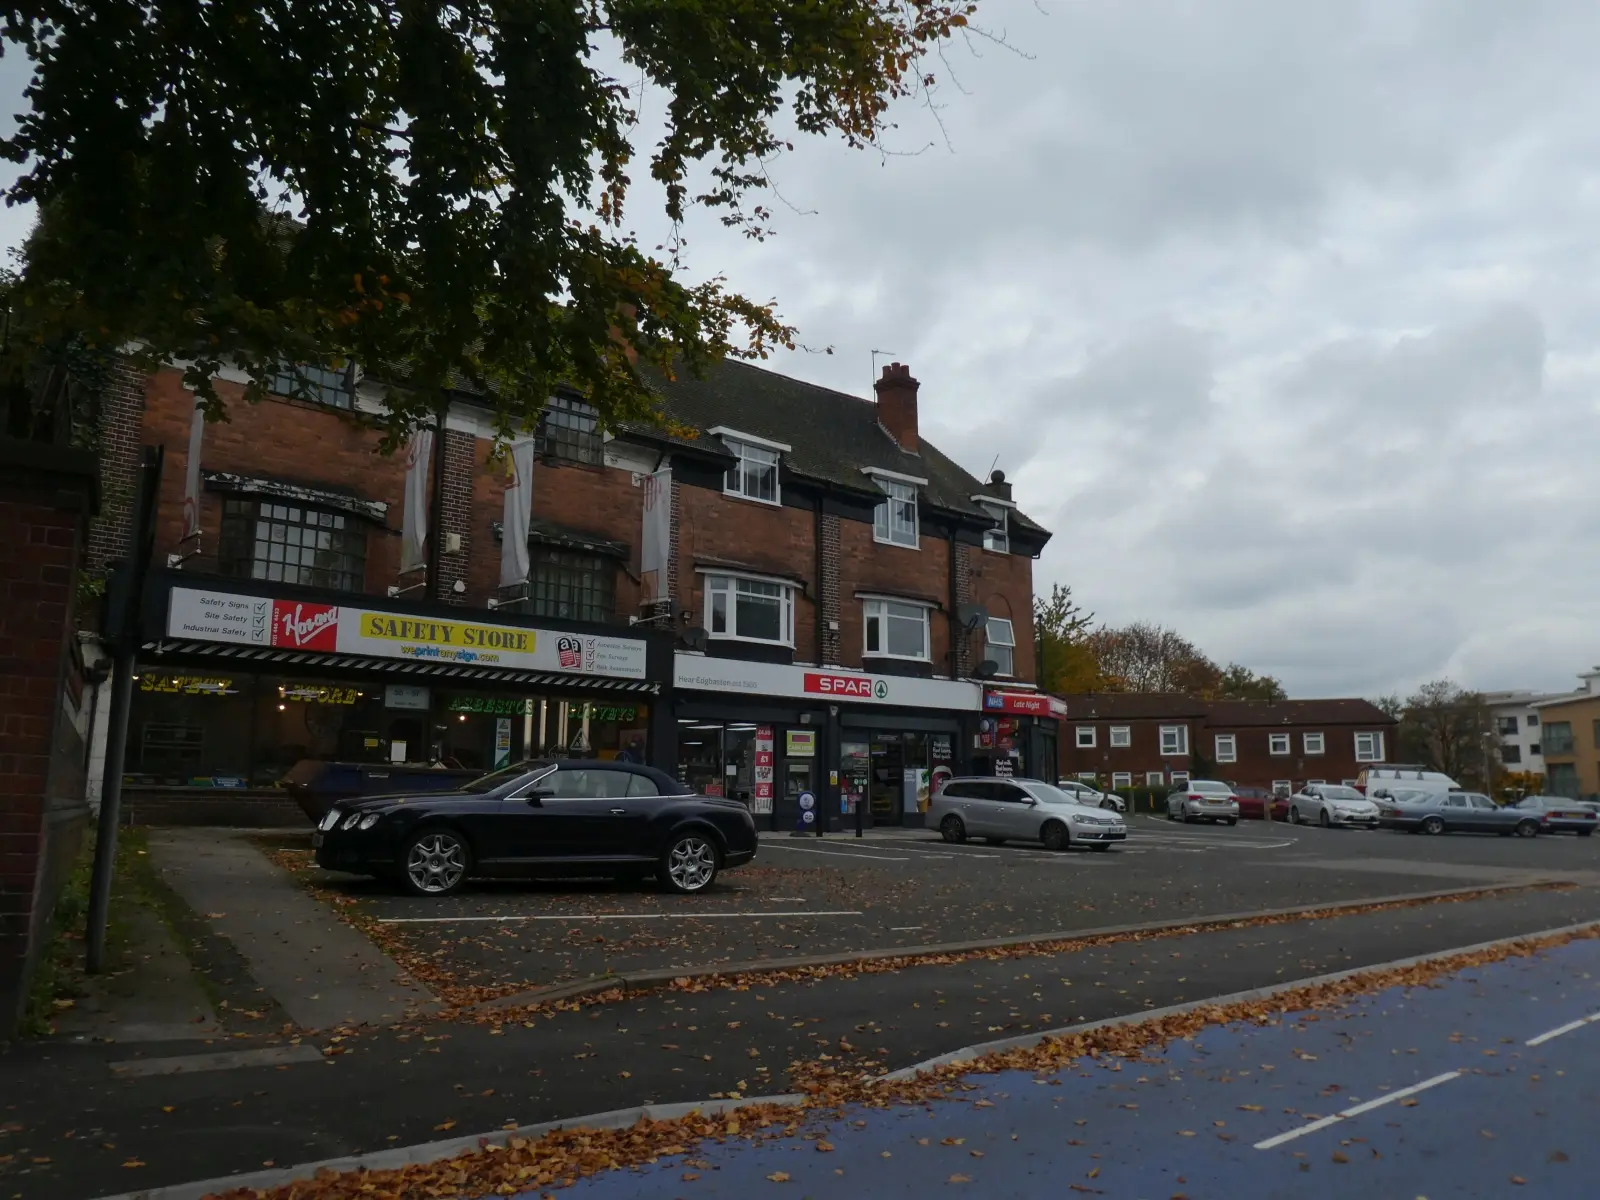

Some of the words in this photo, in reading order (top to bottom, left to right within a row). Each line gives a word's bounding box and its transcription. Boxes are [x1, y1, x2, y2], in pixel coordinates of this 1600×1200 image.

[200, 597, 225, 608] Safety
[228, 600, 250, 611] Signs
[204, 612, 221, 620] Site
[223, 613, 248, 624] Safety
[183, 624, 220, 634] Industrial
[222, 627, 247, 638] Safety
[370, 617, 455, 643] SAFETY
[463, 628, 528, 650] STORE
[400, 645, 500, 663] weprintanysign.com
[695, 676, 731, 686] Edgbaston
[819, 678, 871, 694] SPAR
[988, 696, 1004, 707] NHS
[1013, 700, 1025, 708] Late
[1025, 702, 1041, 710] Night
